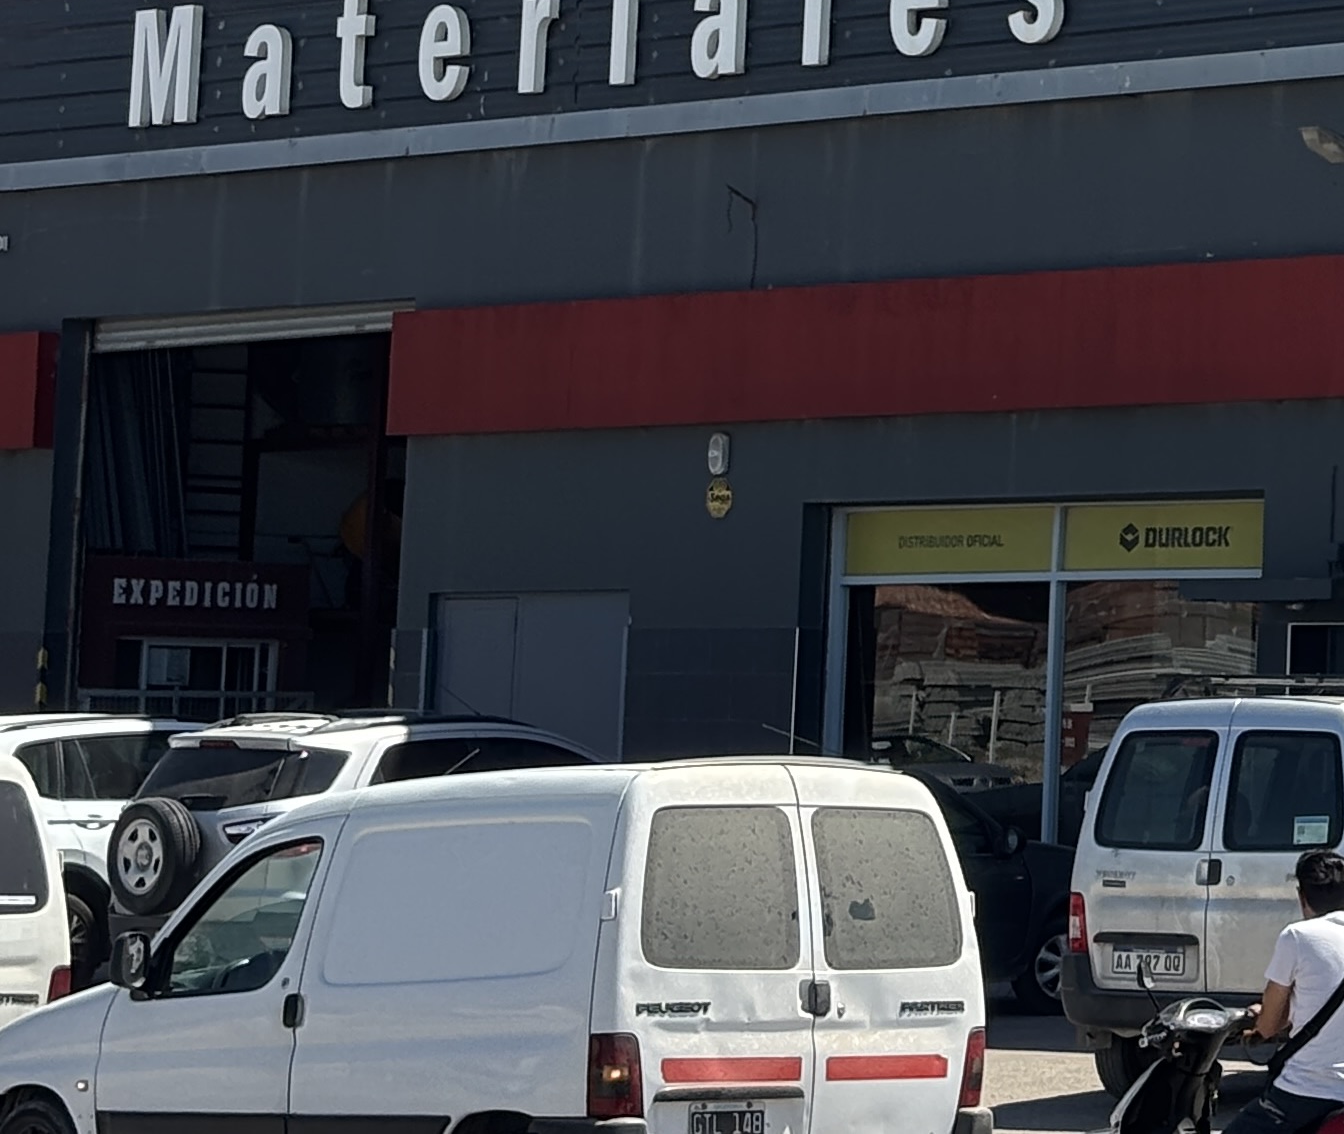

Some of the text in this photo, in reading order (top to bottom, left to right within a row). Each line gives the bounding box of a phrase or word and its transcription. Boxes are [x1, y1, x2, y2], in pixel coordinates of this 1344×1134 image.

[898, 533, 1004, 549] DISTRIBUIDOR OFICIAL
[1145, 526, 1230, 548] DURLOCK
[112, 574, 278, 609] EXPEDICIÓN
[1116, 954, 1132, 970] AA
[636, 1002, 711, 1016] PEUGEOT
[694, 1112, 762, 1134] GTL 148
